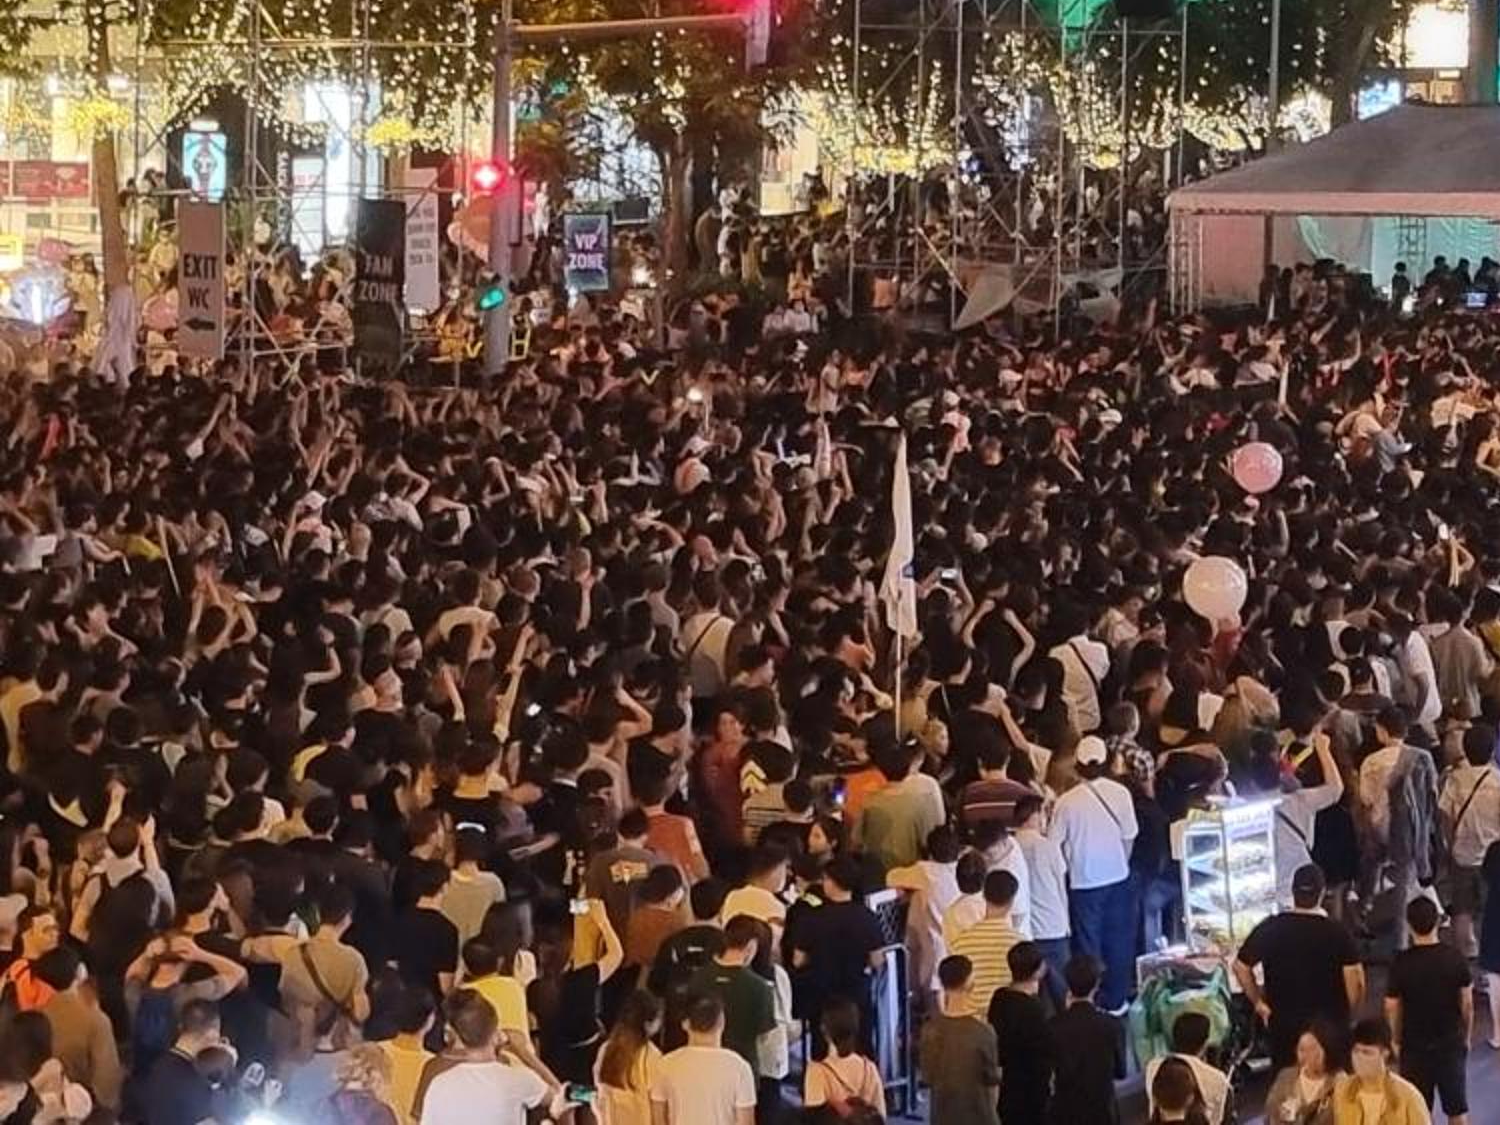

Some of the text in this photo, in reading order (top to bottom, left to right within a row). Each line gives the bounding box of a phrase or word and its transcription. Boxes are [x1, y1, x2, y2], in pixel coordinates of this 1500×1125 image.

[575, 234, 598, 251] VIP
[183, 254, 217, 279] EXIT
[567, 252, 605, 270] ZONE
[187, 286, 209, 311] WC
